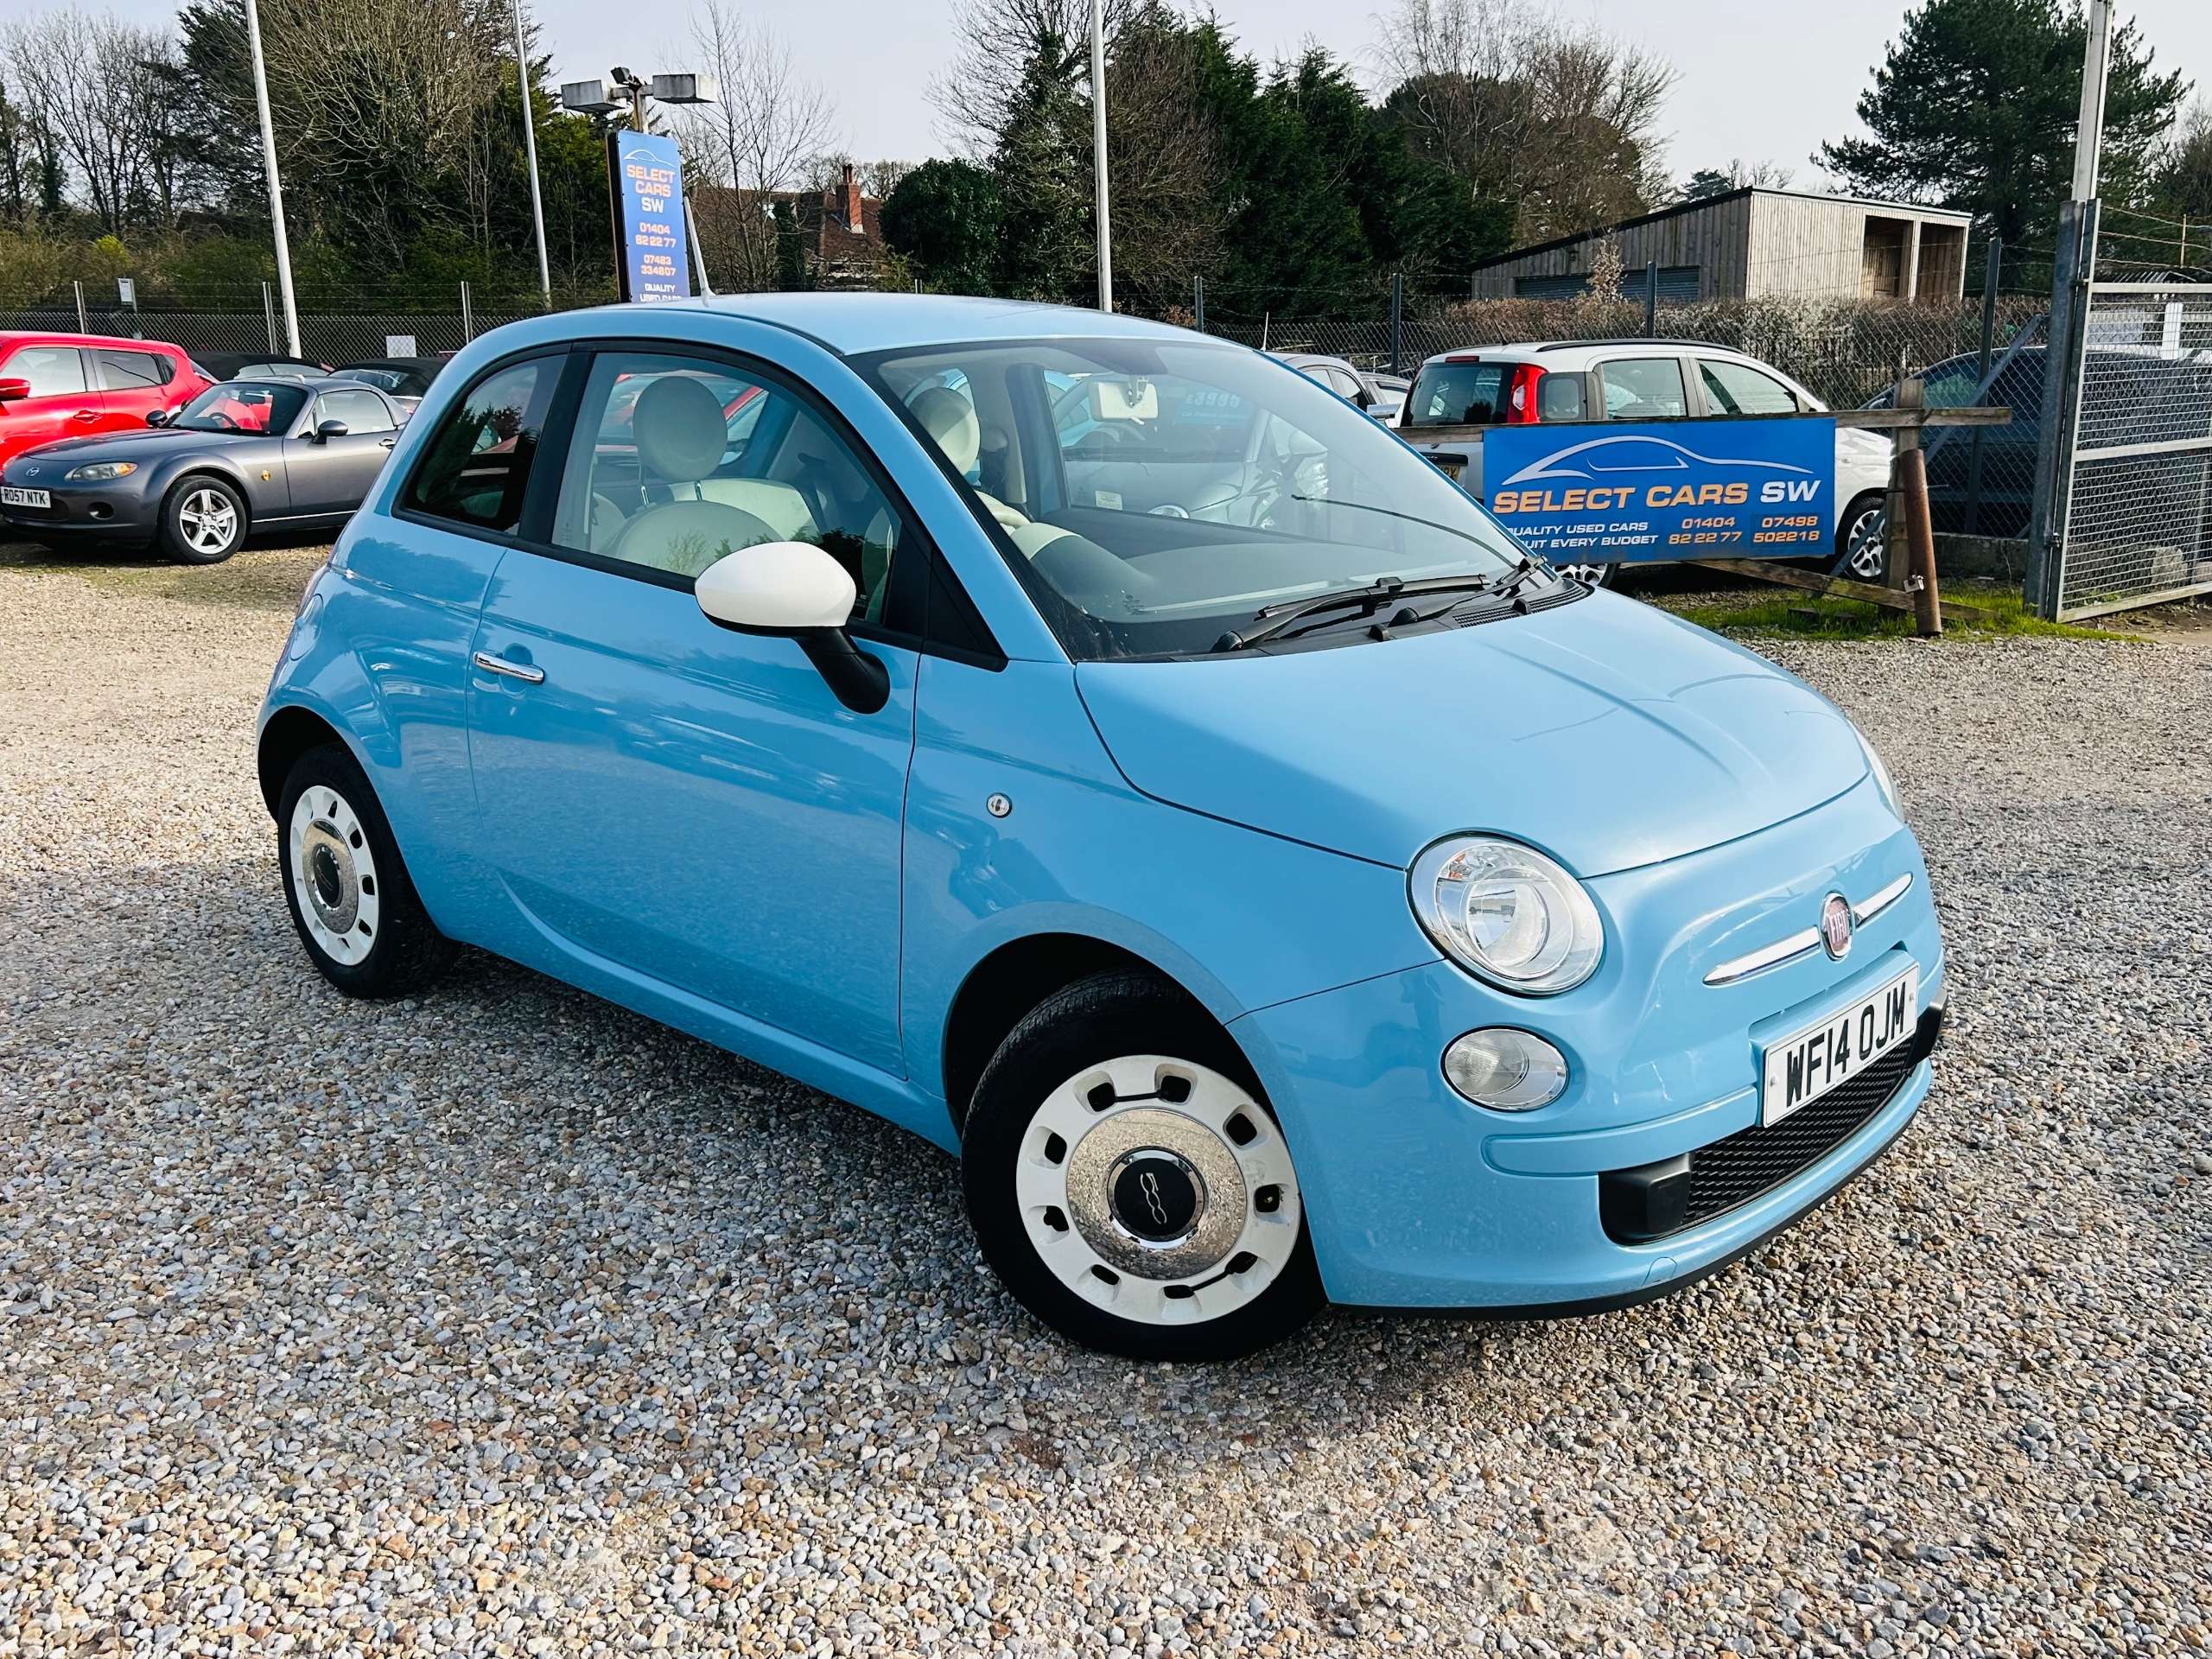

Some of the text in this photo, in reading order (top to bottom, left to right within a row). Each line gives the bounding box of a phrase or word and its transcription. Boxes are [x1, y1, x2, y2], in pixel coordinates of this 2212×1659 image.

[627, 164, 675, 183] SELECT
[636, 179, 671, 198] CARS
[641, 197, 664, 213] SW
[639, 222, 671, 235] 01404
[644, 283, 676, 293] QUALITY
[27, 491, 46, 505] NTK
[1493, 480, 1821, 513] SELECT CARS SW
[1566, 524, 1605, 534] USED
[1609, 522, 1649, 532] CARS
[1681, 517, 1736, 530] 01404
[1761, 516, 1819, 528] 07498
[1521, 535, 1659, 550] UIT EVERY BUDGET
[1753, 531, 1820, 543] 502218
[1785, 981, 1907, 1109] WF14 OJM
